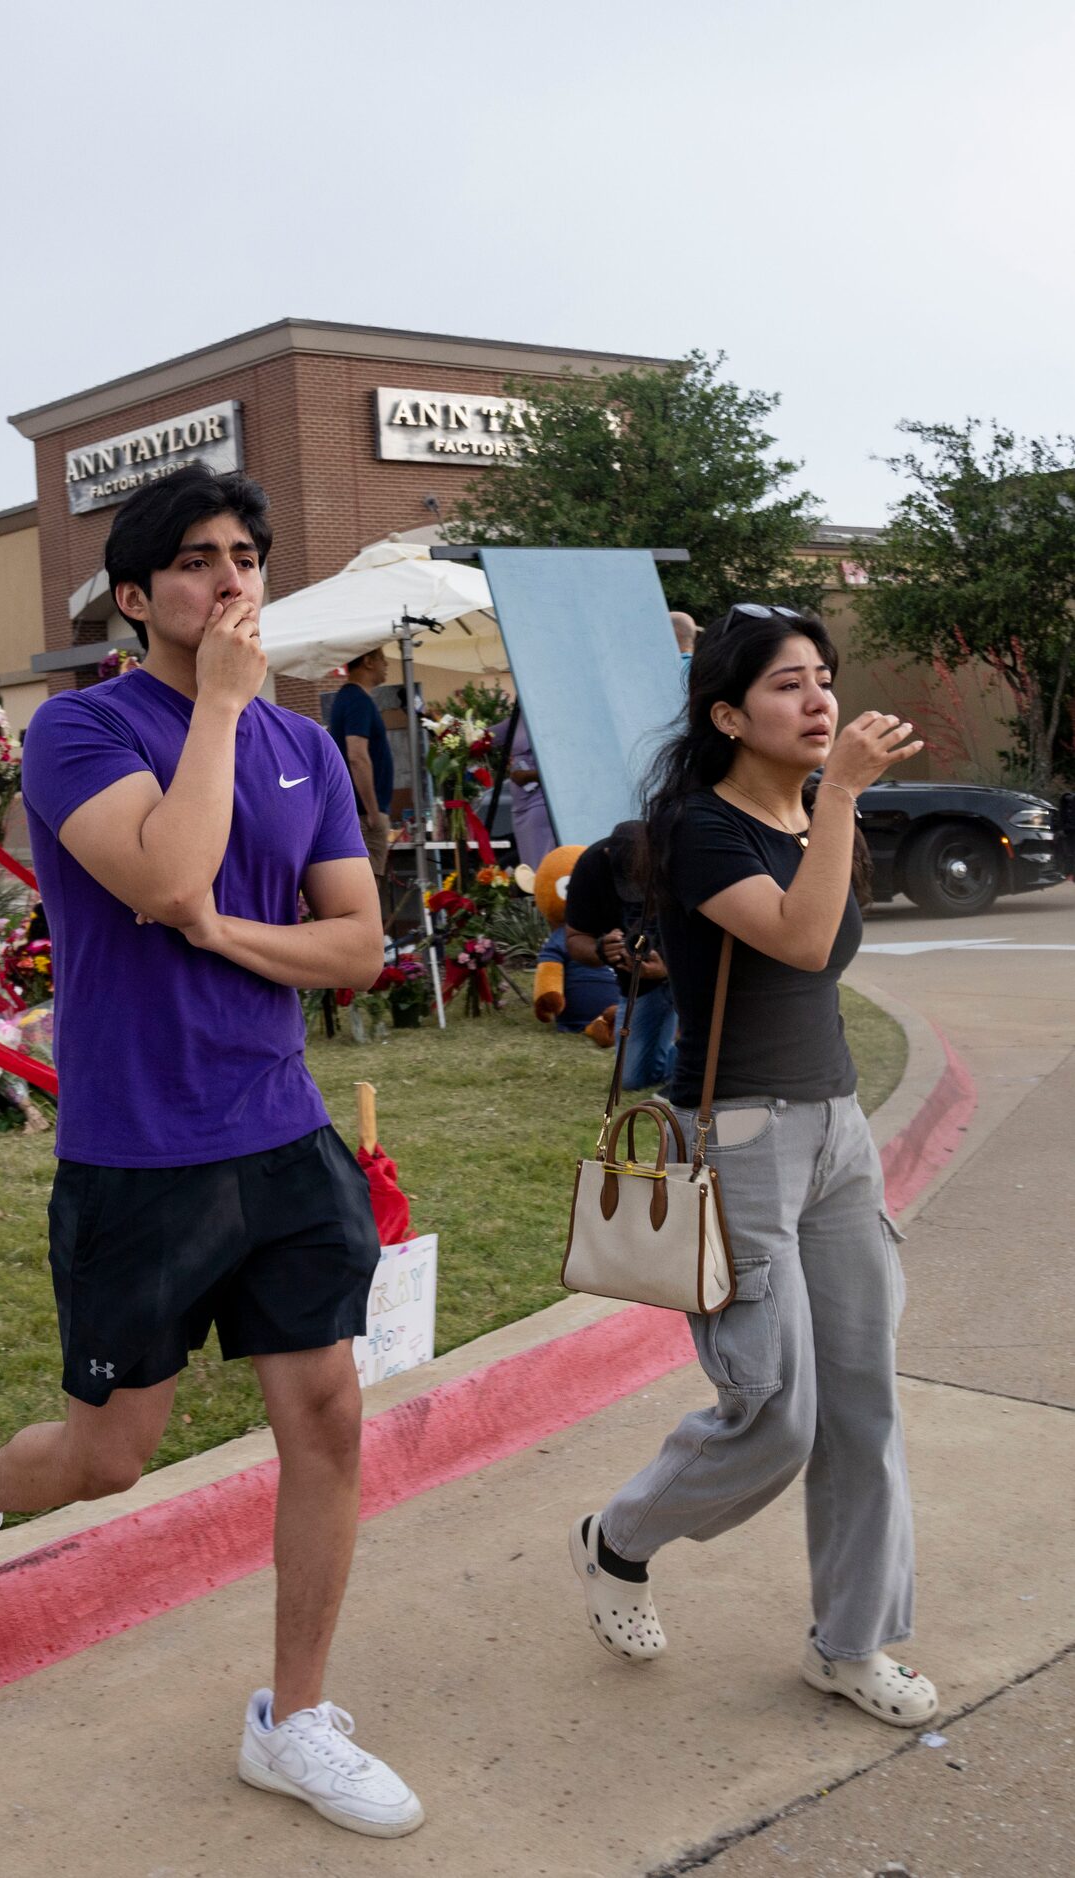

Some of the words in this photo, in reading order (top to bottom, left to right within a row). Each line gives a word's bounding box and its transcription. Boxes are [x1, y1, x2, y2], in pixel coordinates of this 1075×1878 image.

[393, 399, 471, 429] ANN
[65, 446, 116, 483] ANN
[122, 414, 223, 465] TAYLOR
[90, 471, 146, 498] FACTORY
